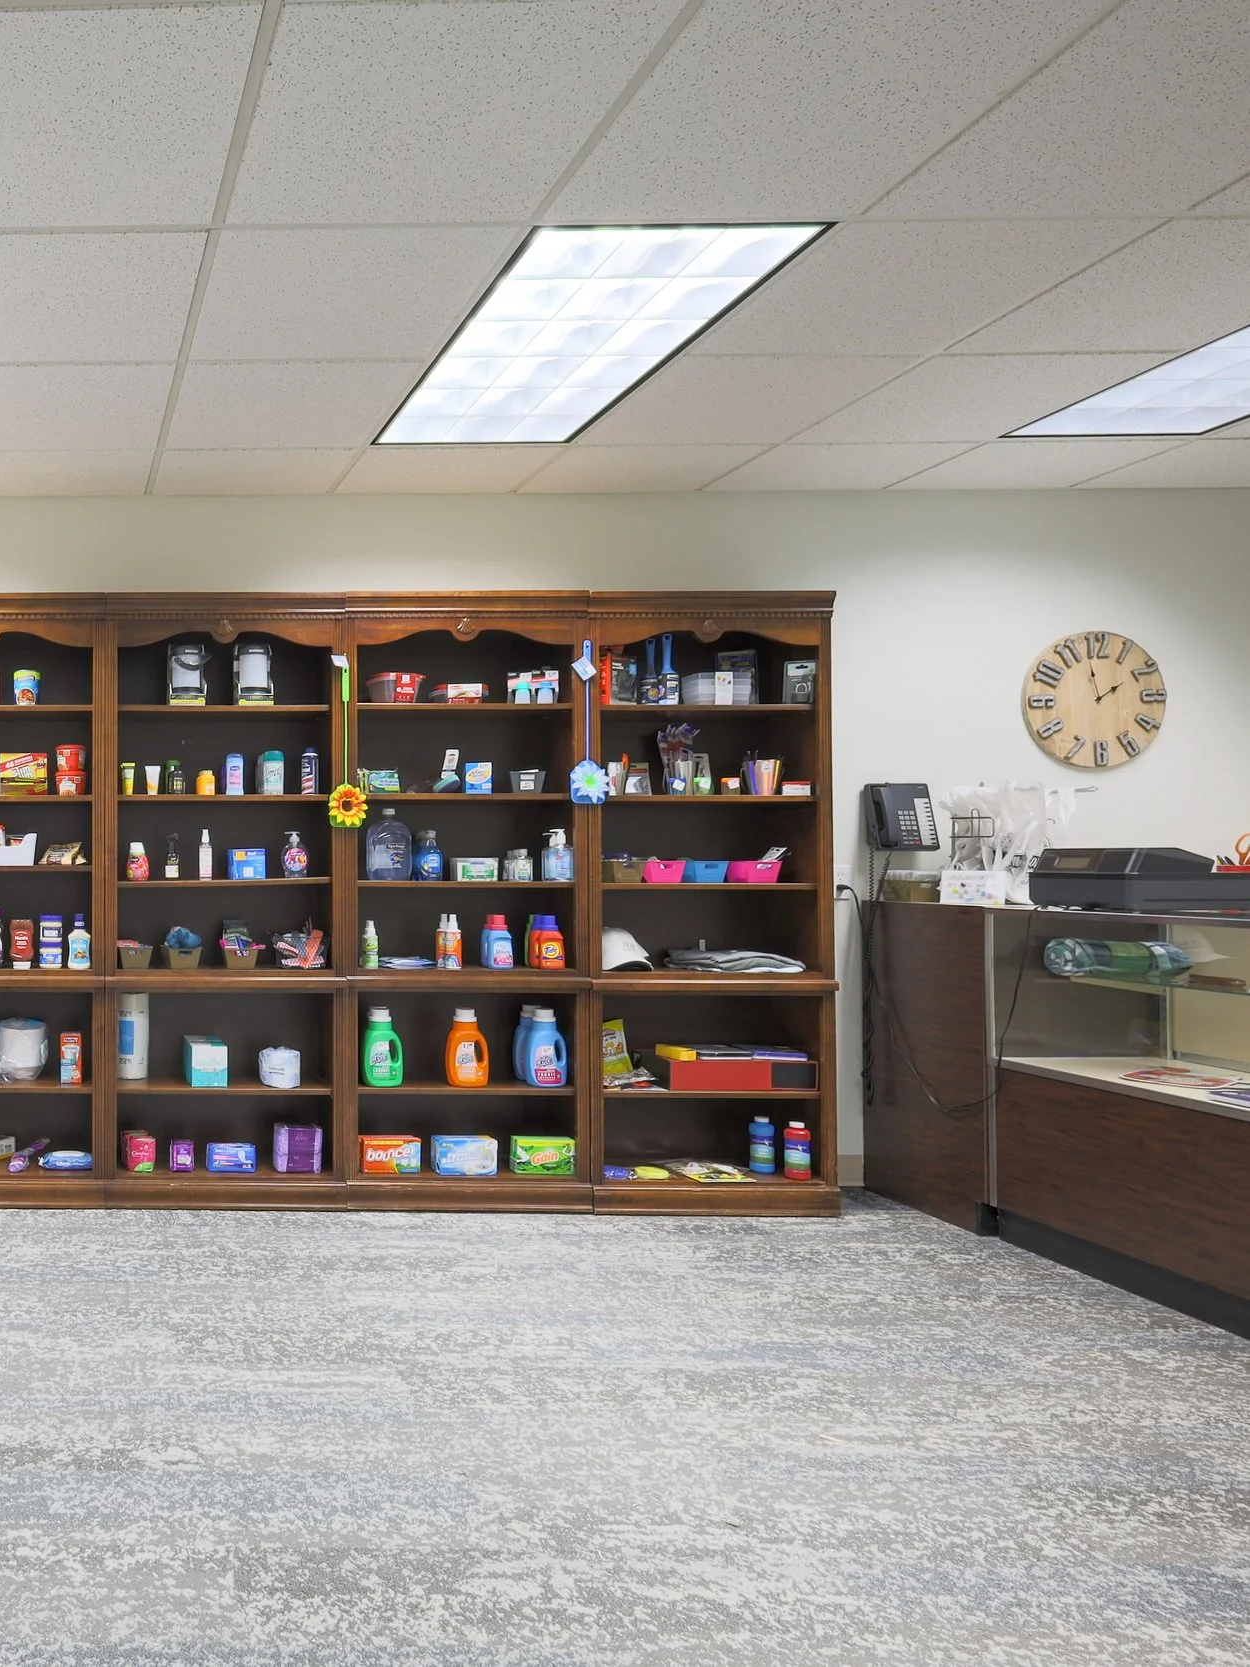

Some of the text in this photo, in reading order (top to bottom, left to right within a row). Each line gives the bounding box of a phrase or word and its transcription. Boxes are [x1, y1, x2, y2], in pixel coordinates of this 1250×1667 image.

[1054, 637, 1083, 668] 11
[1084, 631, 1110, 660] 12
[1116, 638, 1135, 665] 1
[1032, 659, 1065, 689] 10
[1130, 657, 1159, 683] 2
[1028, 694, 1056, 709] 9
[1140, 688, 1167, 702] 3
[1037, 717, 1065, 740] 8
[1134, 713, 1161, 732] 4
[1063, 734, 1086, 761] 7
[1094, 739, 1109, 767] 6
[1116, 730, 1141, 758] 5
[365, 1146, 411, 1163] bounce
[530, 1151, 559, 1165] Gain
